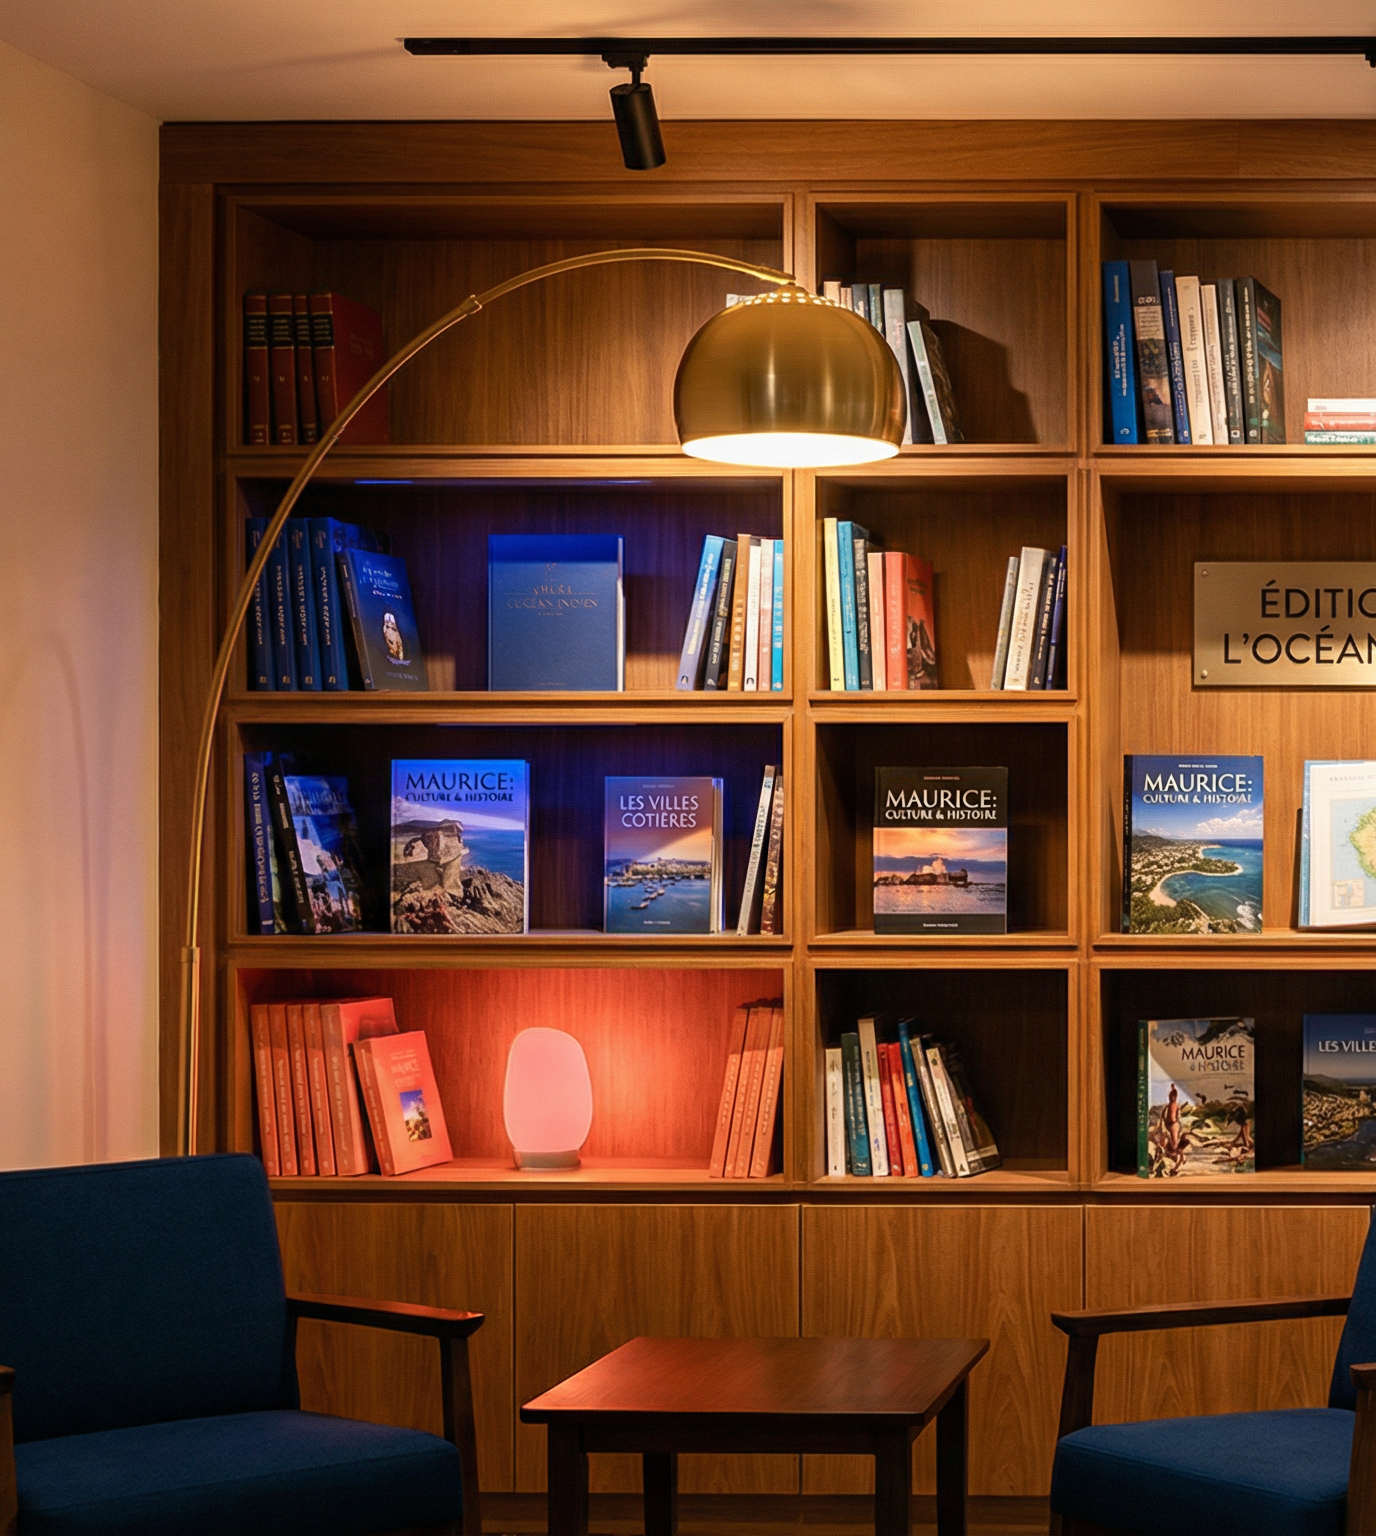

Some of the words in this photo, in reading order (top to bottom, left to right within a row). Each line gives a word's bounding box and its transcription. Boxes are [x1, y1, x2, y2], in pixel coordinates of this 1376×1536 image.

[405, 772, 514, 791] MAURICE:
[1143, 773, 1253, 793] MAURICE:
[620, 795, 645, 811] LES
[648, 795, 699, 811] VILLES
[885, 789, 997, 809] MAURICE:
[1181, 1045, 1246, 1061] MAURICE
[1318, 1040, 1340, 1053] LES
